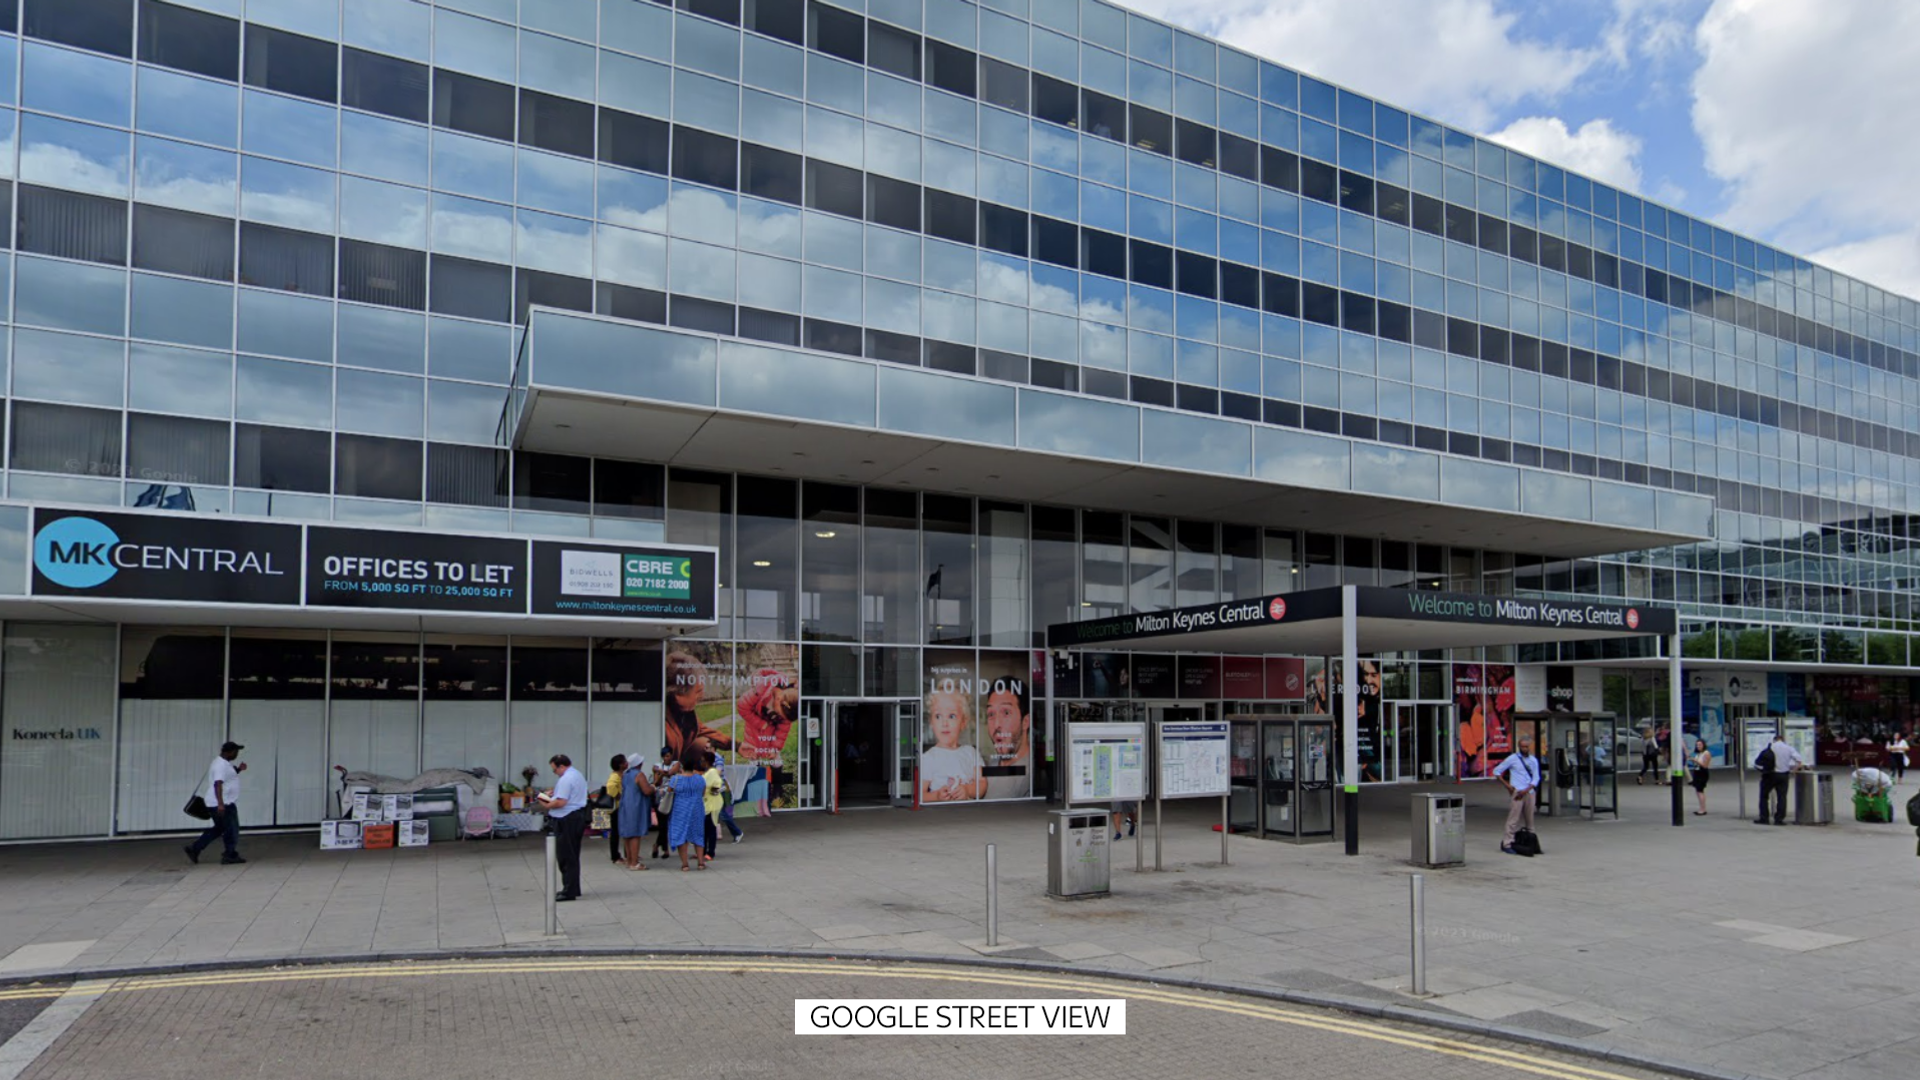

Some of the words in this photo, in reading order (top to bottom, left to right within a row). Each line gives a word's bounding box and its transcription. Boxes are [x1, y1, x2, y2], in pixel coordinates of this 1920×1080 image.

[324, 556, 428, 580] OFFICES
[433, 561, 464, 582] TO
[470, 563, 514, 584] LET
[569, 568, 614, 577] BIDWELLS
[626, 559, 673, 575] CBRE
[324, 580, 359, 591] FROM
[361, 581, 392, 594] 5,000
[394, 583, 410, 594] SQ
[412, 584, 426, 595] FT
[429, 585, 442, 595] TO
[445, 586, 481, 598] 25,000
[483, 587, 498, 598] SQ
[499, 587, 514, 599] FT
[626, 577, 643, 587] 020
[645, 578, 666, 589] 7182
[667, 579, 689, 590] 2000
[555, 600, 697, 614] www.miltonkeynescentral.co.uk
[1409, 593, 1475, 617] Welcome
[1478, 602, 1493, 618] to
[1495, 599, 1537, 621] Milton
[1540, 602, 1583, 627] Keynes
[1585, 605, 1623, 626] Central
[1077, 621, 1121, 639] Welcome
[1123, 620, 1134, 634] to
[1136, 615, 1170, 633] Milton
[1172, 609, 1215, 632] Keynes
[1219, 600, 1265, 624] Central
[676, 675, 789, 687] NORTHAMPTON
[931, 678, 1022, 695] LONDON
[1456, 685, 1511, 695] BIRMINGHAM
[1552, 686, 1573, 700] shop
[12, 727, 74, 740] Konecta
[76, 727, 101, 740] UK
